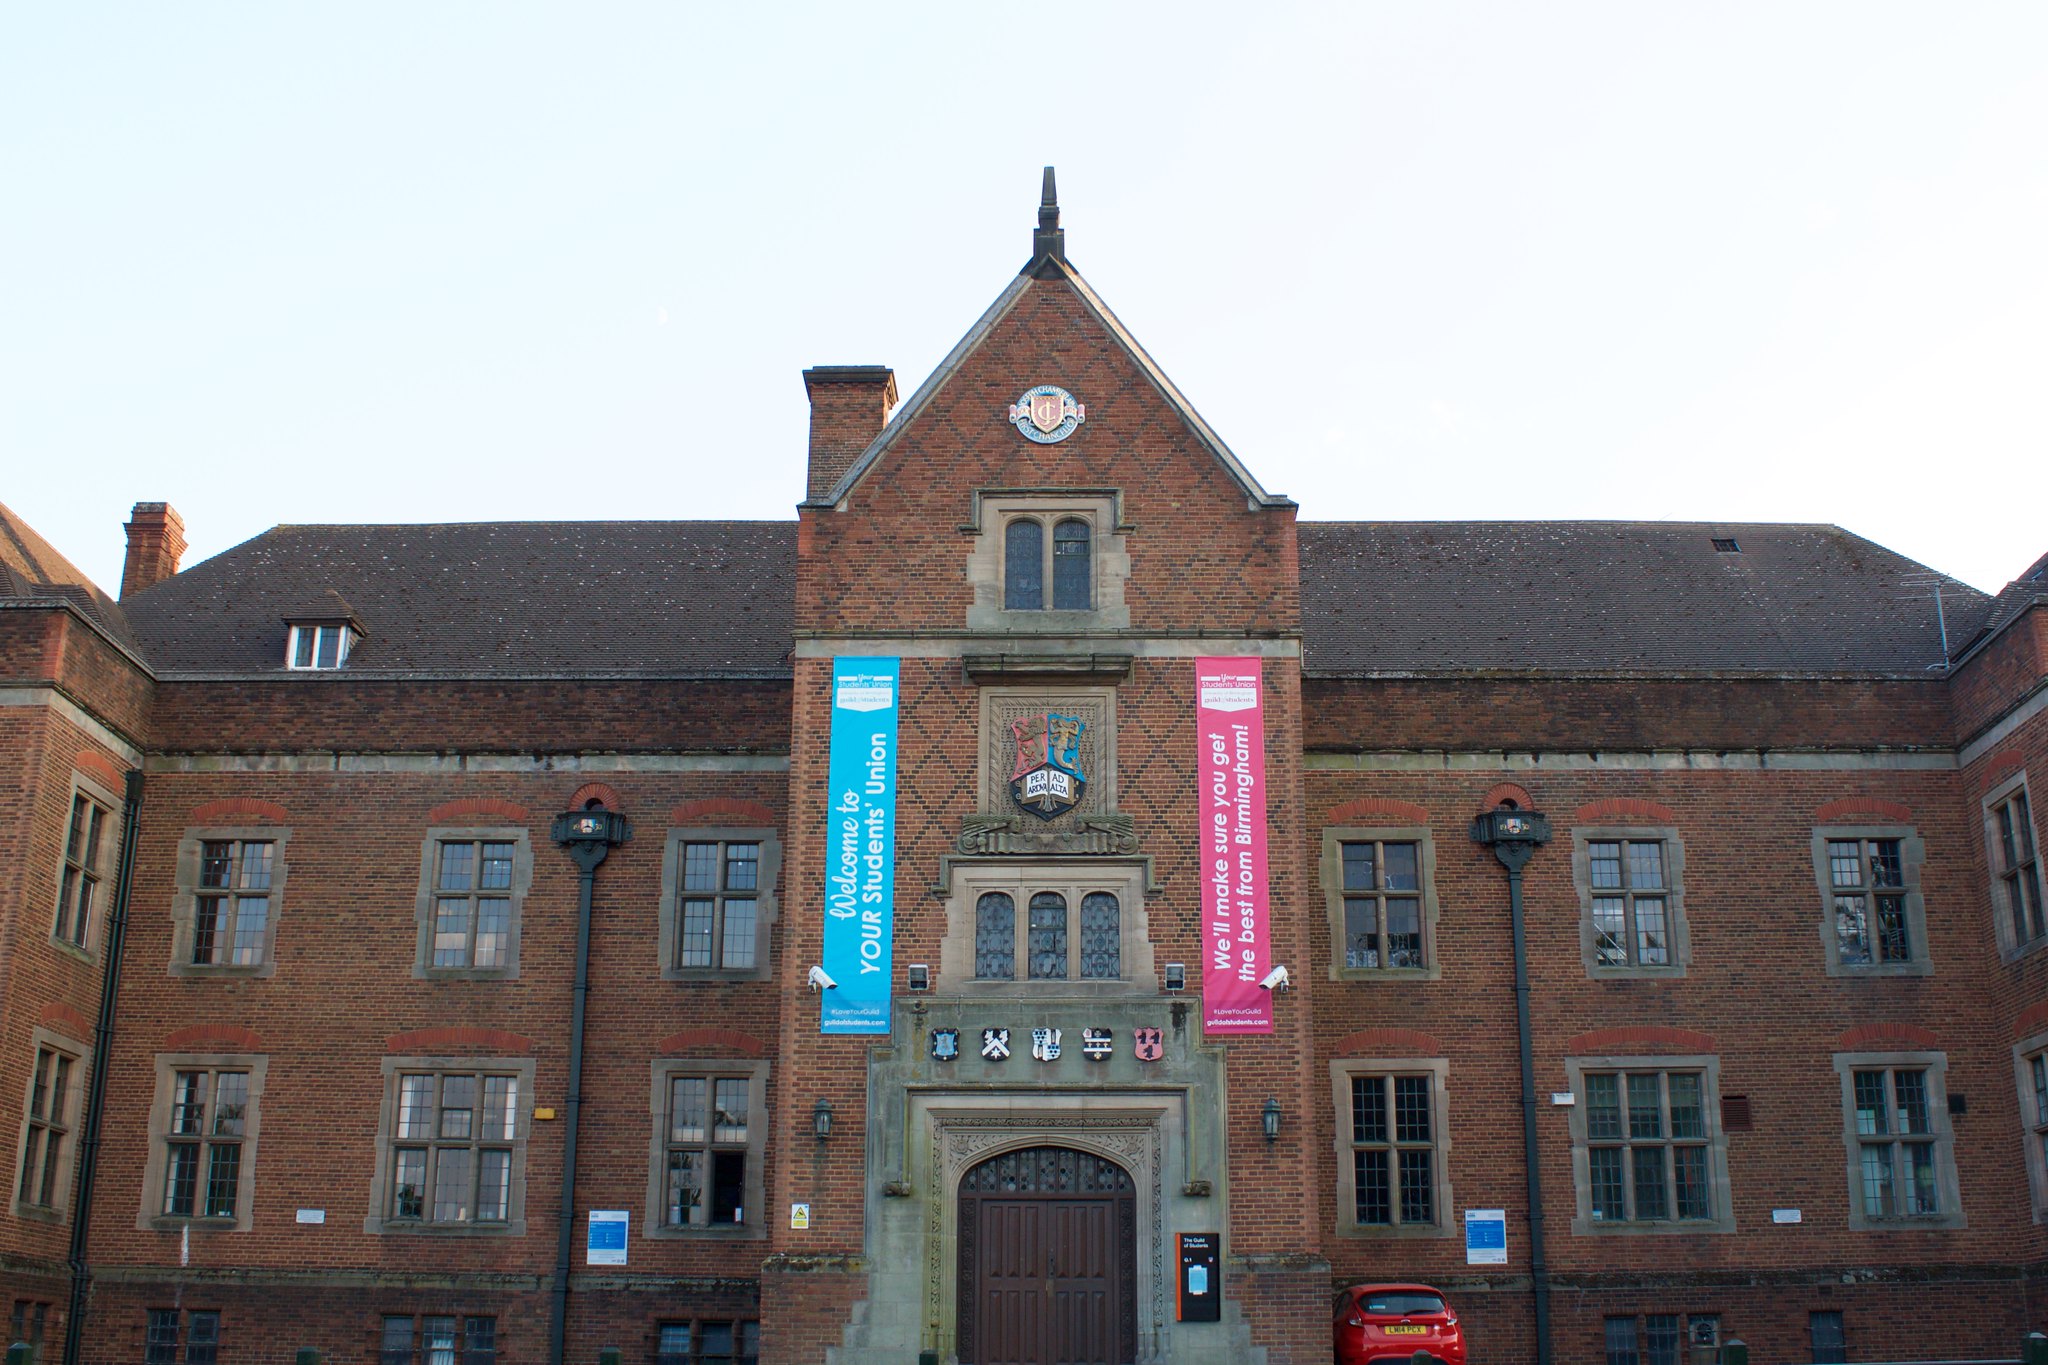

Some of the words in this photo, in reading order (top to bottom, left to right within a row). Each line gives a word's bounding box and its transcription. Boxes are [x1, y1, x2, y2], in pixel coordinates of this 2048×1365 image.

[1220, 673, 1237, 683] Your
[865, 733, 887, 795] Union
[1208, 732, 1230, 766] get
[1030, 772, 1046, 784] PER
[1050, 783, 1068, 795] ALTA
[1052, 773, 1065, 784] AD
[1213, 771, 1231, 807] you
[1231, 724, 1254, 845] Birmingham!
[836, 788, 860, 814] to
[1214, 812, 1228, 854] sure
[829, 817, 859, 921] Welcome
[1211, 859, 1230, 917] make
[1235, 851, 1254, 896] from
[860, 910, 882, 975] YOUR
[1236, 900, 1255, 943] best
[1213, 921, 1231, 970] We'll
[1238, 949, 1256, 982] the
